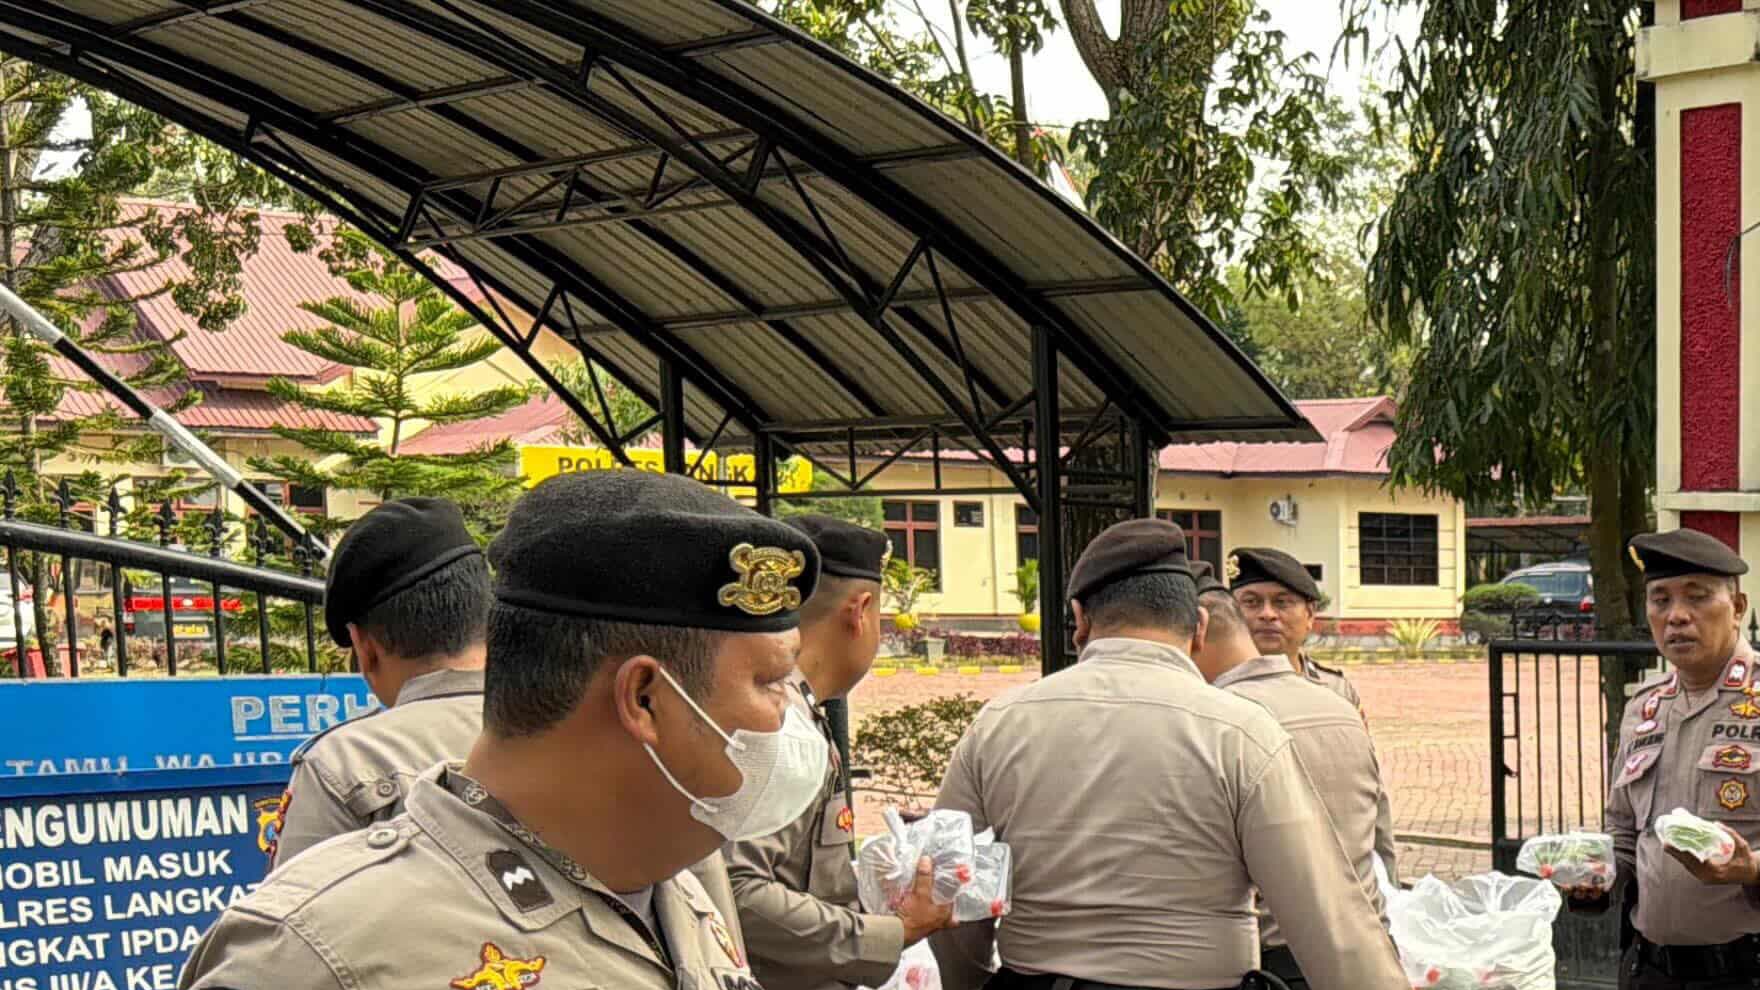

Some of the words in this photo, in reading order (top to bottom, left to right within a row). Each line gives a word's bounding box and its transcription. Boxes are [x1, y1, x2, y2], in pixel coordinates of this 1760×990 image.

[0, 794, 248, 849] NGUMUMAN
[0, 859, 94, 892] OBIL
[104, 849, 233, 883] MASUK
[121, 925, 201, 957] IPDA
